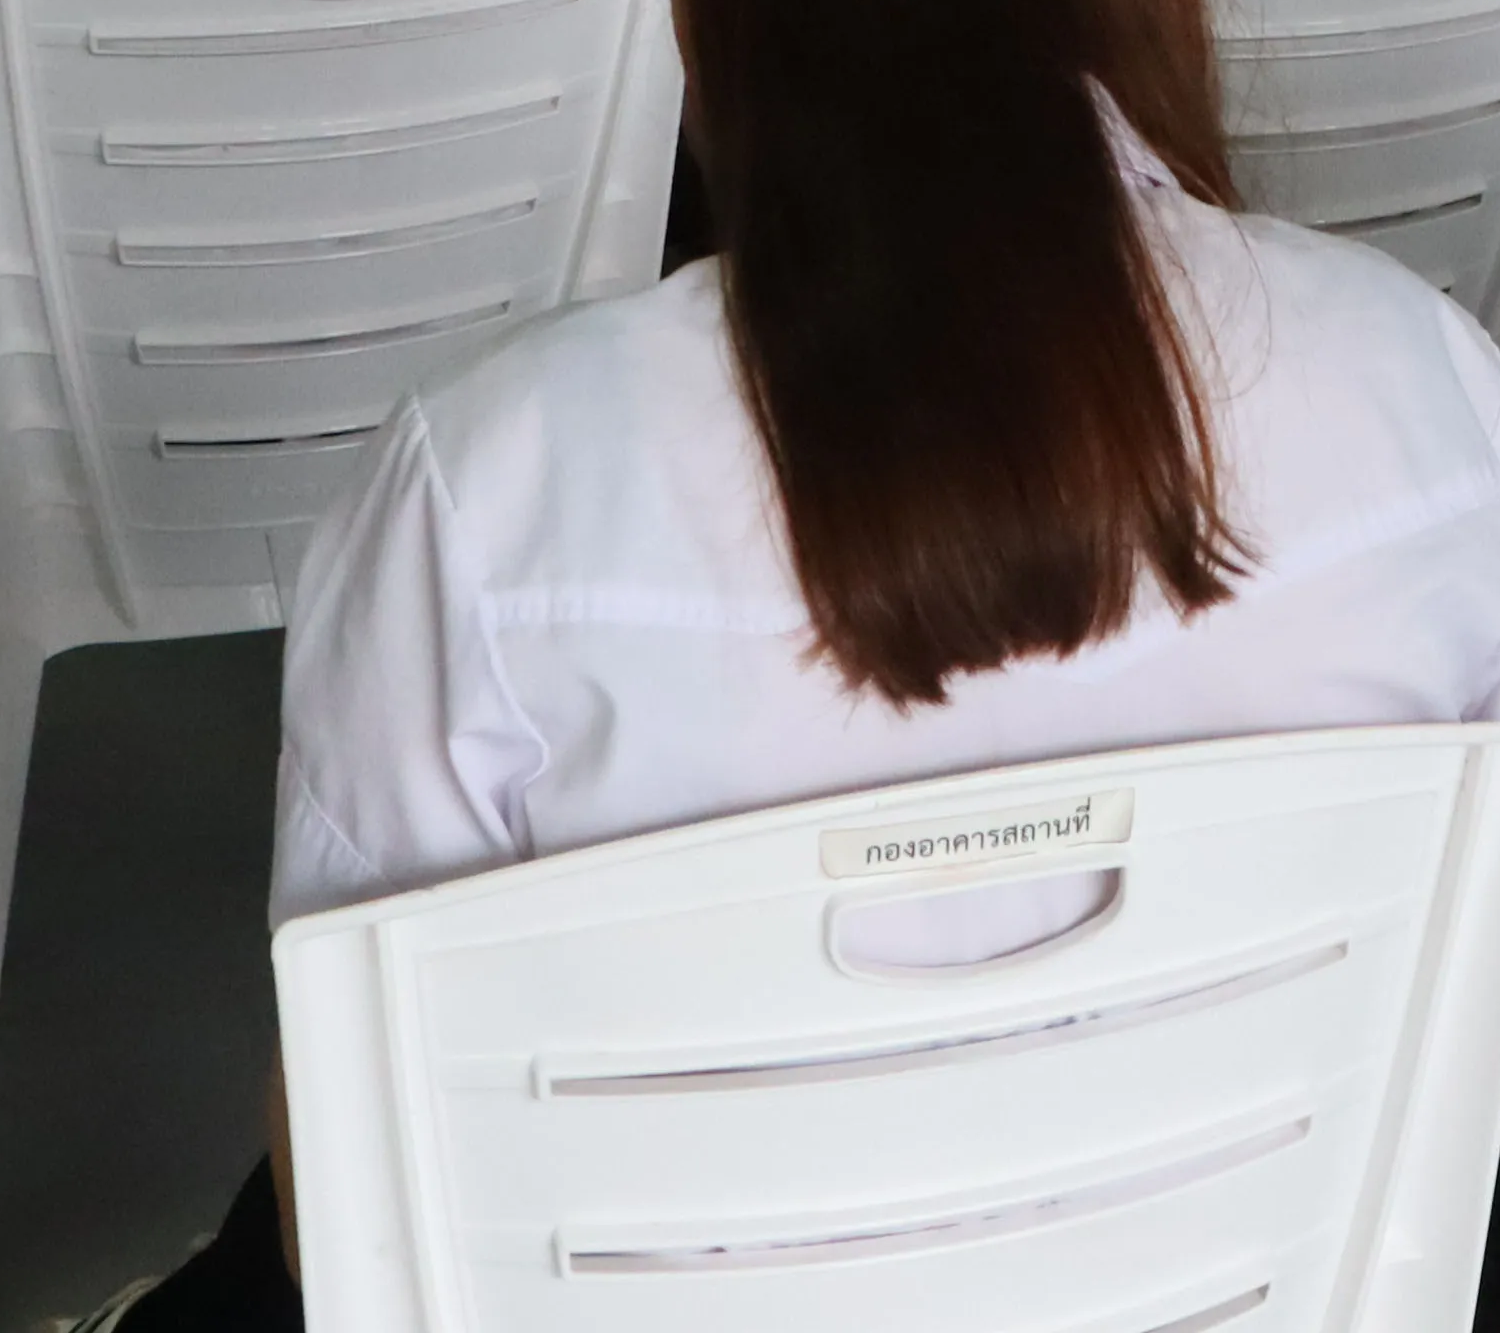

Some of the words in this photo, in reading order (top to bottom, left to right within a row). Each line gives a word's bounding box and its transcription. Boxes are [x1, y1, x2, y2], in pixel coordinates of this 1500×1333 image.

[864, 797, 1092, 865] กองอาคารสถานที่
